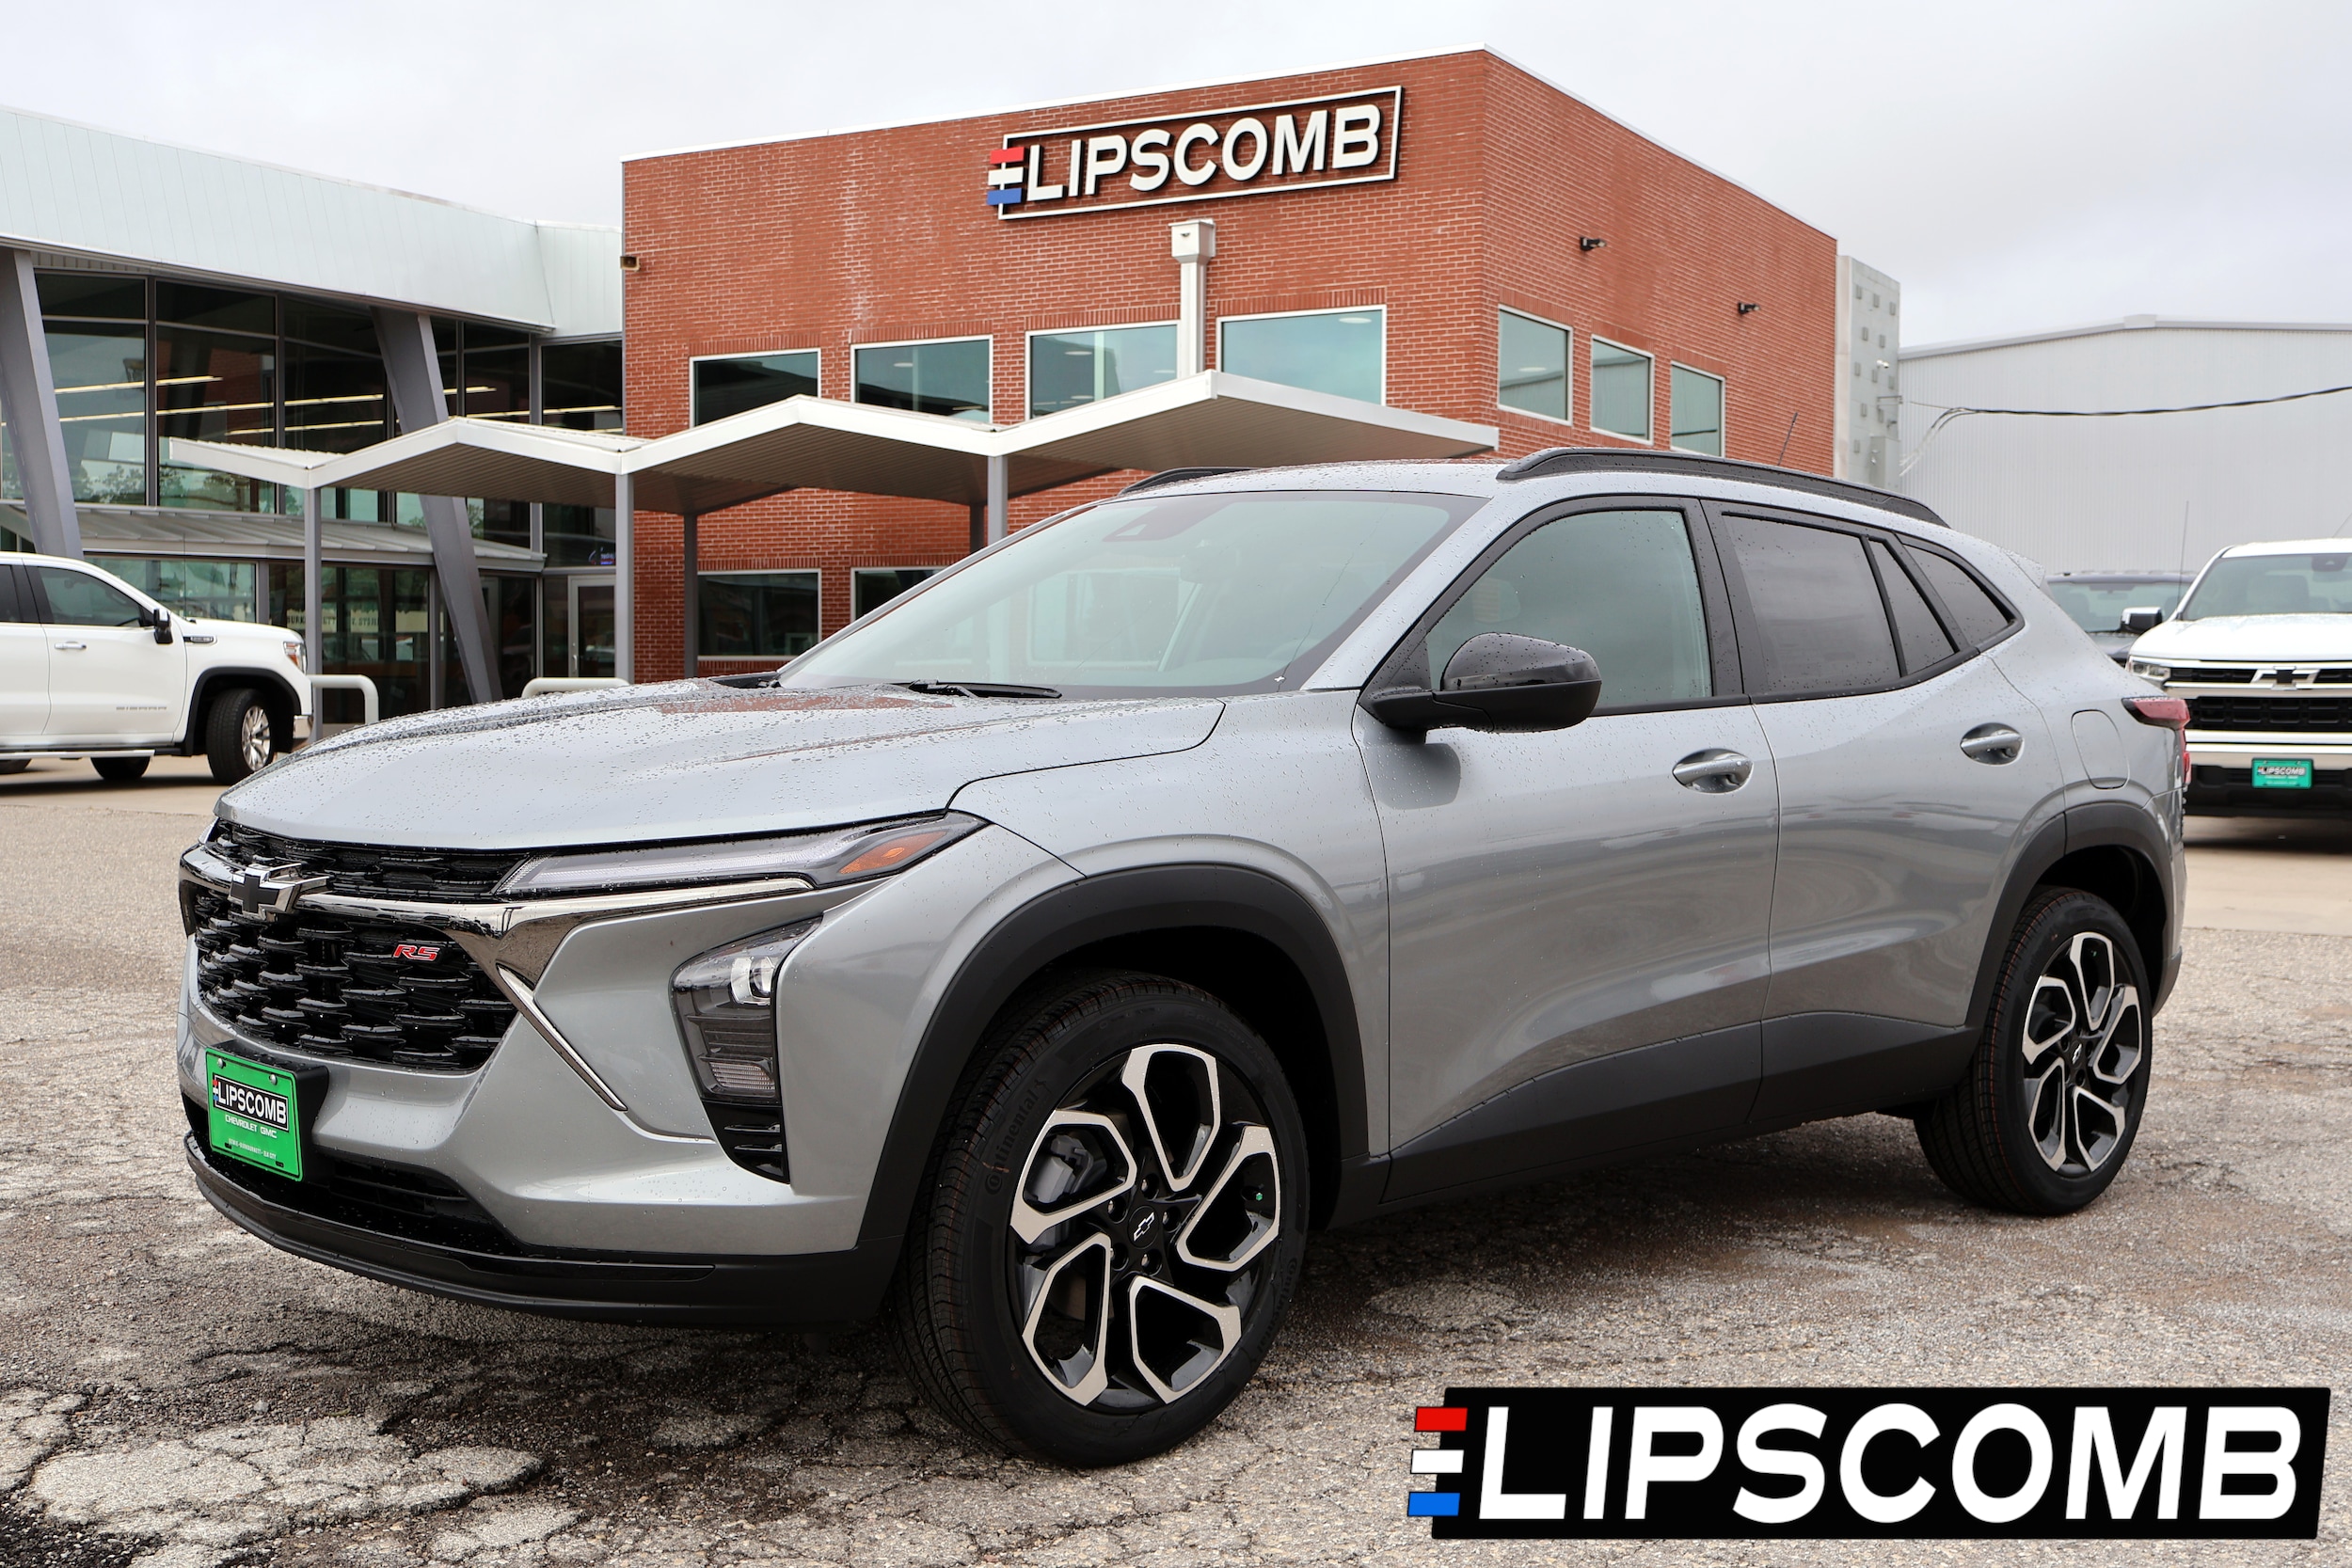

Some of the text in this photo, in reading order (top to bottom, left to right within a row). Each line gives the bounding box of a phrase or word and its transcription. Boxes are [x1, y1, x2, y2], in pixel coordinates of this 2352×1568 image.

[1026, 103, 1382, 201] LIPSCOMB
[393, 943, 440, 961] RS
[217, 1081, 287, 1125] LIPSCOMB
[225, 1114, 278, 1139] CHEVROLET GMC
